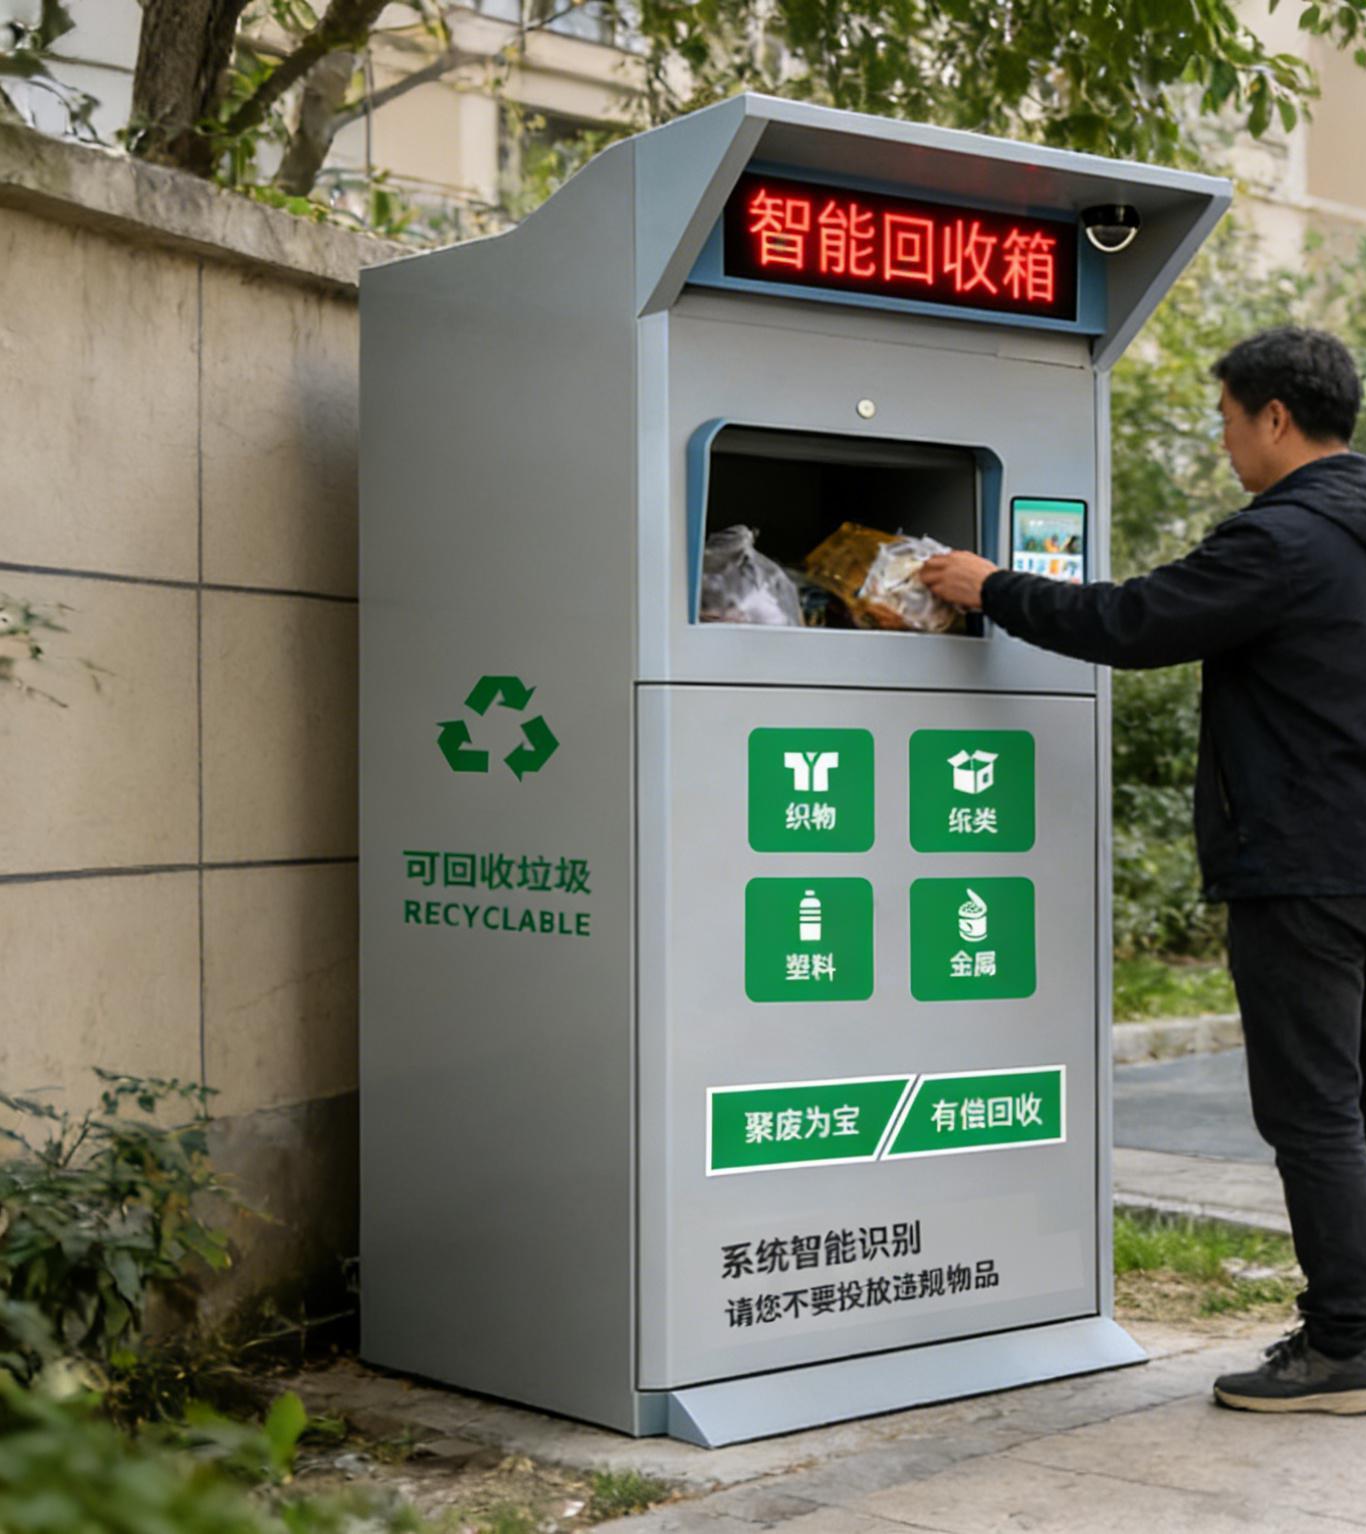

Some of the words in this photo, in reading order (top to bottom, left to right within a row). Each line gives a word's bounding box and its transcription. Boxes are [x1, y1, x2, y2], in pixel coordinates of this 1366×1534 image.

[749, 188, 1057, 302] 智能回收箱
[785, 802, 837, 830] 织物
[948, 807, 998, 834] 纸类
[401, 849, 592, 895] 可回收垃圾
[403, 899, 592, 937] RECYCLABLE
[785, 953, 837, 981] 塑料
[949, 950, 997, 977] 金属
[744, 1104, 860, 1144] 聚废为宝
[930, 1092, 1043, 1133] 有偿回收
[721, 1219, 921, 1280] 系统智能识别
